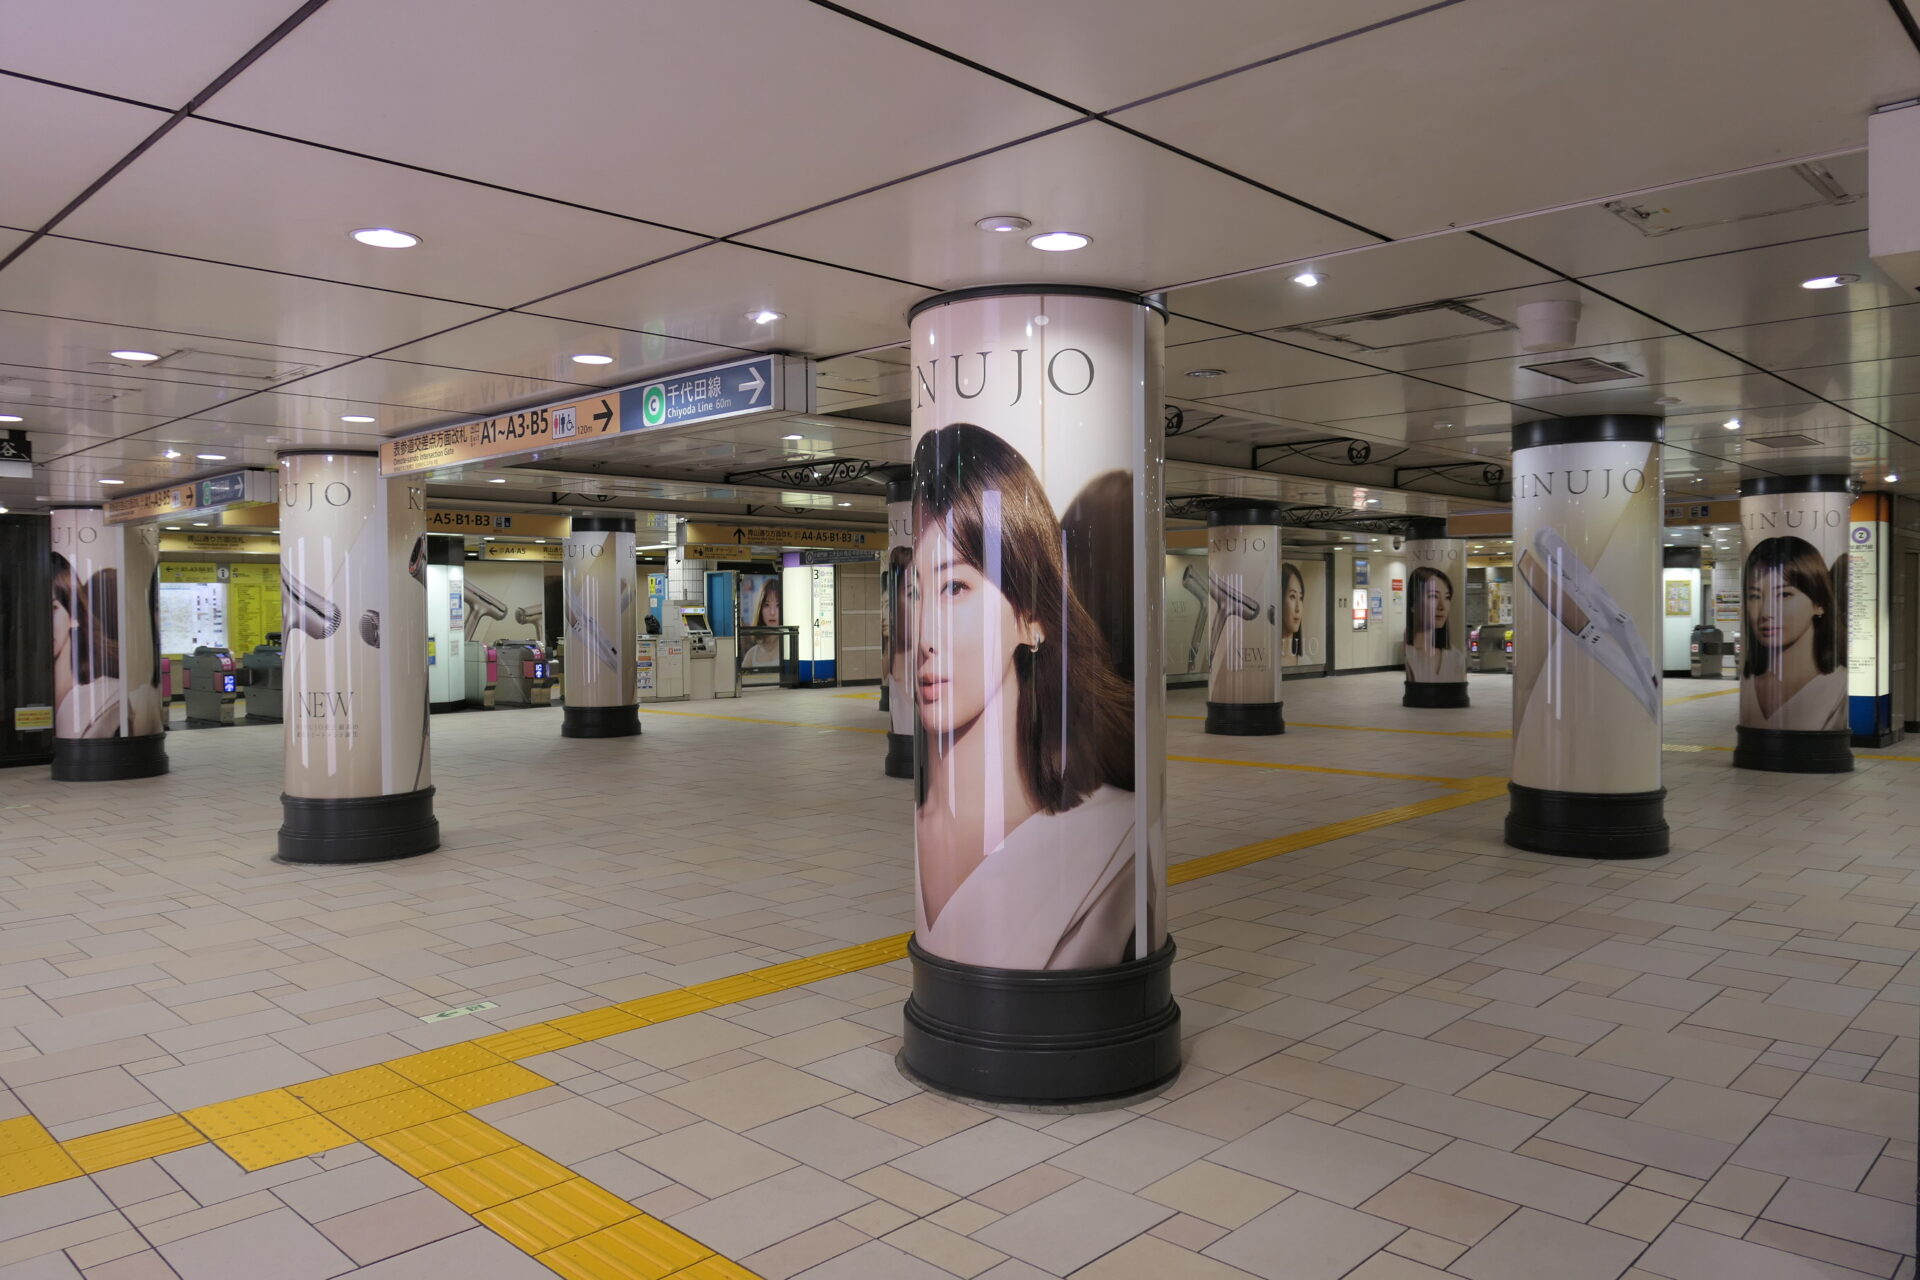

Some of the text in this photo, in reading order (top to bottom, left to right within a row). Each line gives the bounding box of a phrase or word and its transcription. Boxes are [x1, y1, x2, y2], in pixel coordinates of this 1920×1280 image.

[917, 348, 1095, 408] NUJO
[667, 376, 722, 406] 千代田線
[667, 398, 732, 419] Chiyoda Line 60m
[577, 425, 593, 435] 120m
[393, 427, 468, 457] 表参道交差点方面改札
[445, 448, 455, 456] Gate
[407, 486, 422, 511] K
[814, 569, 819, 580] 3
[814, 618, 820, 628] 4
[298, 691, 355, 718] NEW
